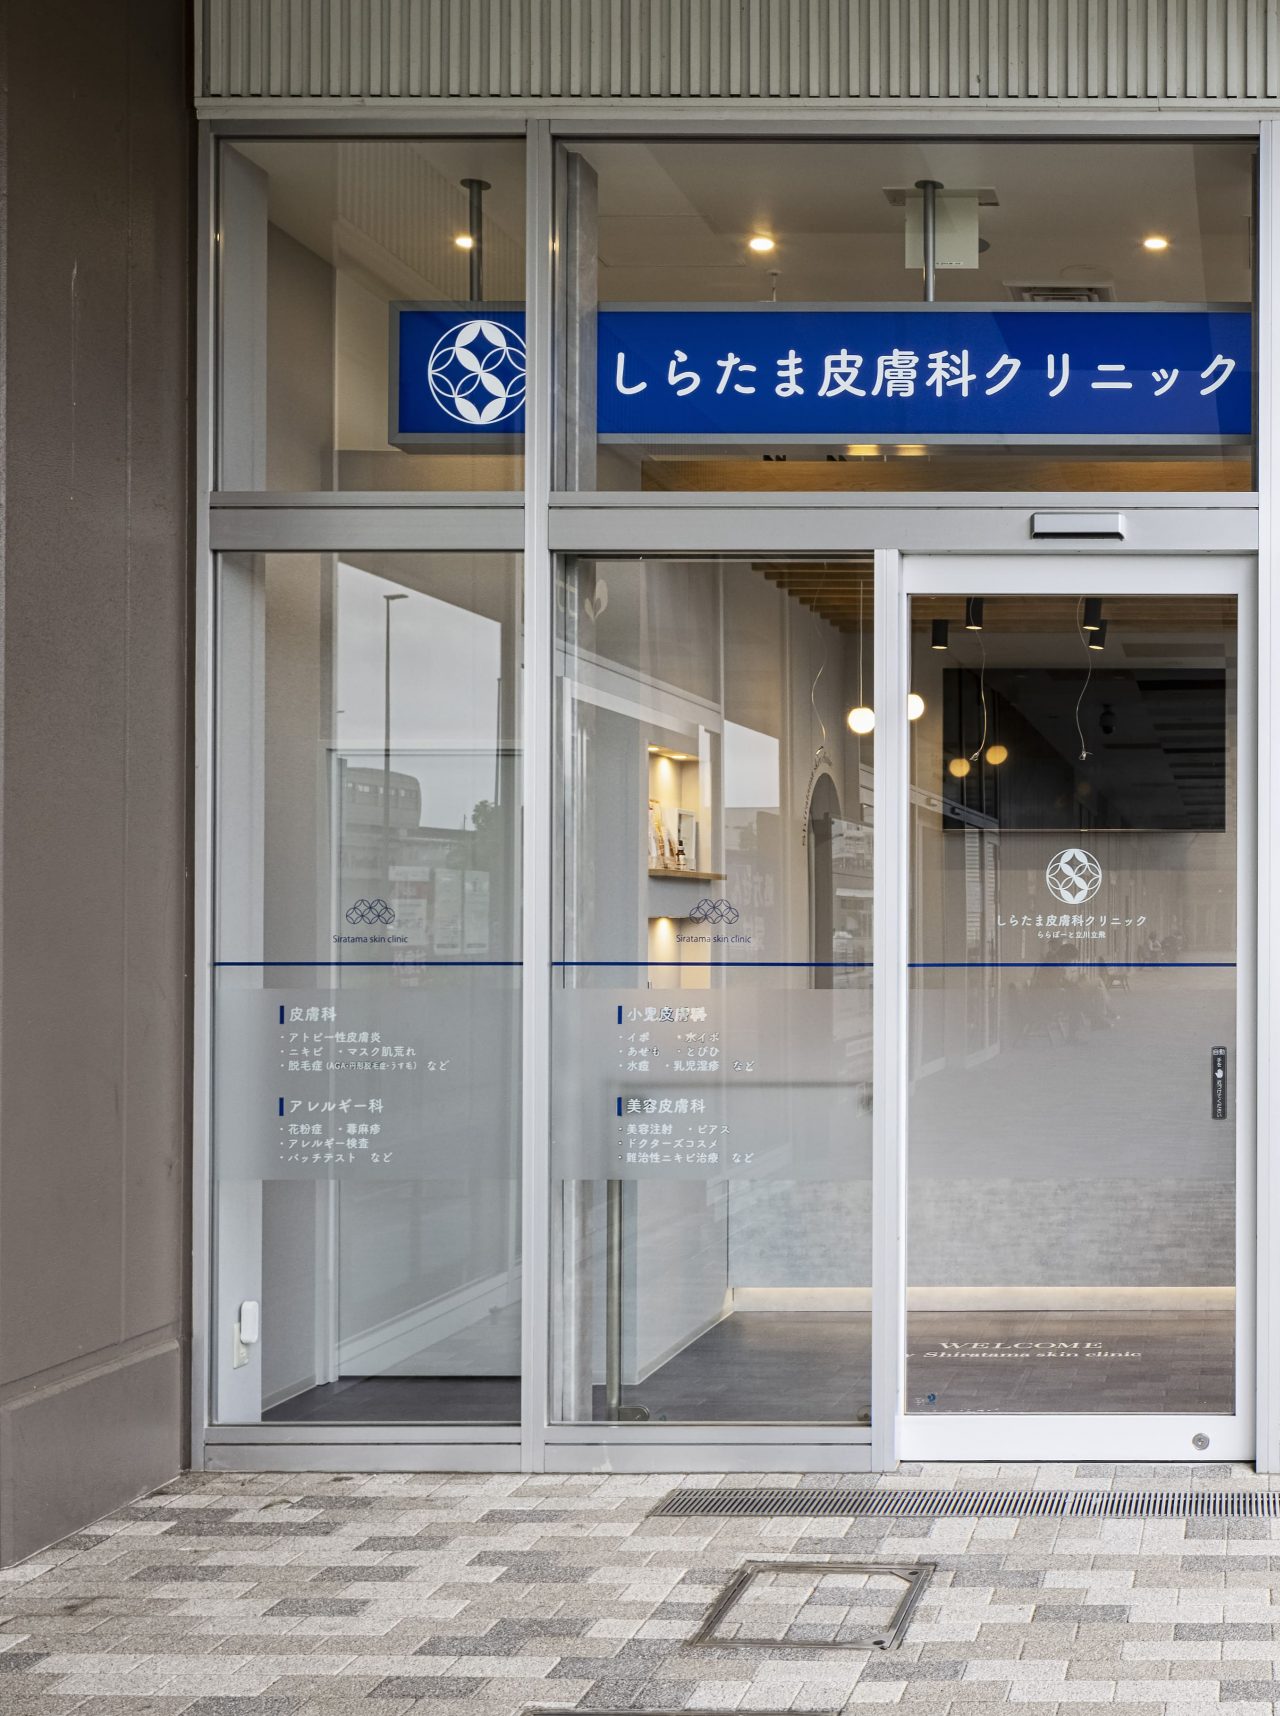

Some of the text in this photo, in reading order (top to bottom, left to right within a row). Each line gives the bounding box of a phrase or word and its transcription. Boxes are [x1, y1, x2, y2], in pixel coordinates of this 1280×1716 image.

[614, 349, 1237, 399] しらたま皮膚科クリニック
[997, 914, 1147, 927] しらたま皮膚科クリニック
[332, 934, 409, 944] Siratama skin clinic
[676, 934, 752, 944] Siratama skin clinic
[289, 1006, 337, 1023] 皮膚科
[289, 1098, 385, 1114] アレルギー科
[626, 1098, 706, 1114] 美容皮膚科
[938, 1341, 1104, 1349] WELCOME
